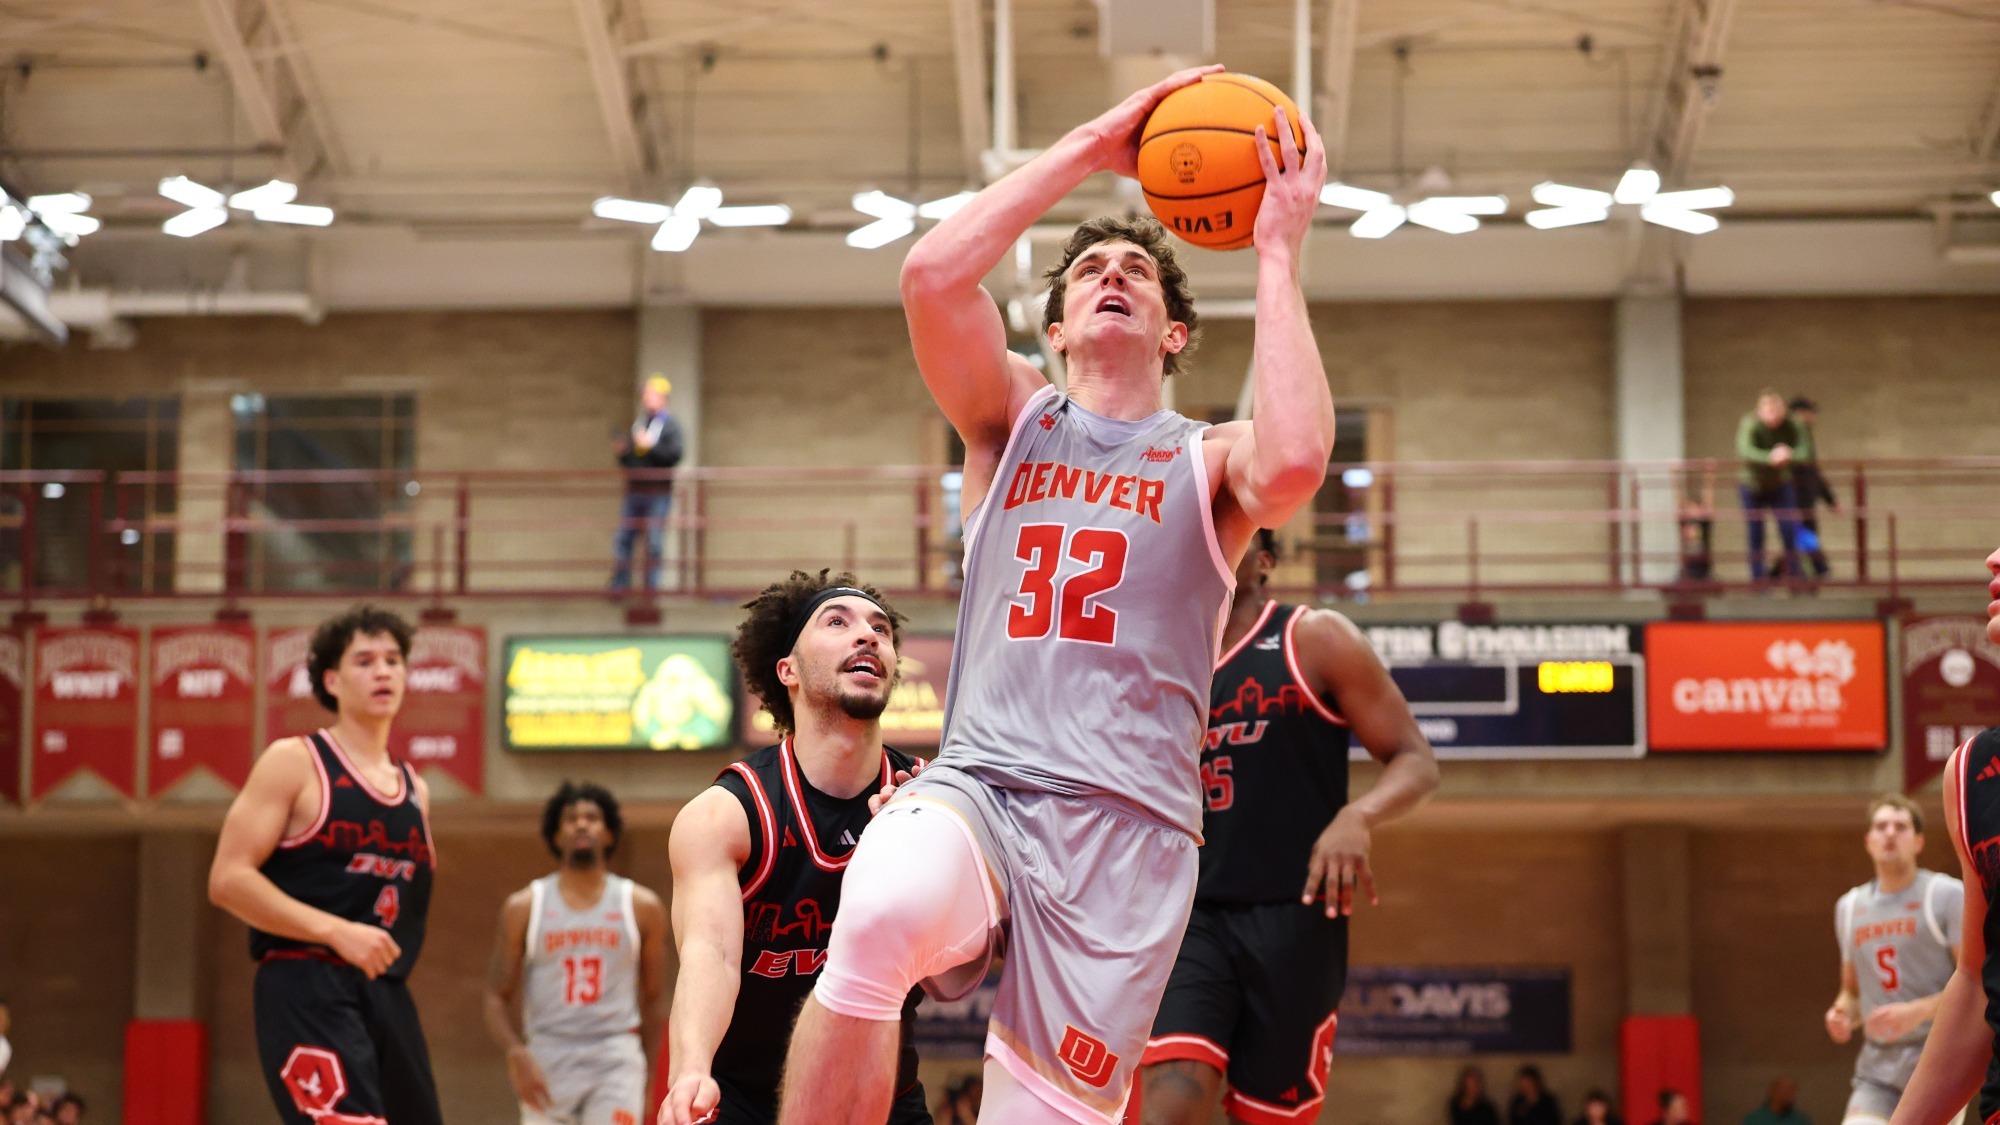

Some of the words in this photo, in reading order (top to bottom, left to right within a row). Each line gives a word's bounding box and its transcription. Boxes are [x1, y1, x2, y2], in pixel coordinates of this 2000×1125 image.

[1173, 210, 1233, 234] EVO
[1003, 461, 1166, 526] DENVER
[1006, 521, 1130, 647] 32
[1672, 678, 1841, 714] canvas
[373, 884, 400, 928] 4
[1853, 917, 1918, 947] DENVER
[562, 955, 605, 1006] 13
[1876, 946, 1899, 992] 5
